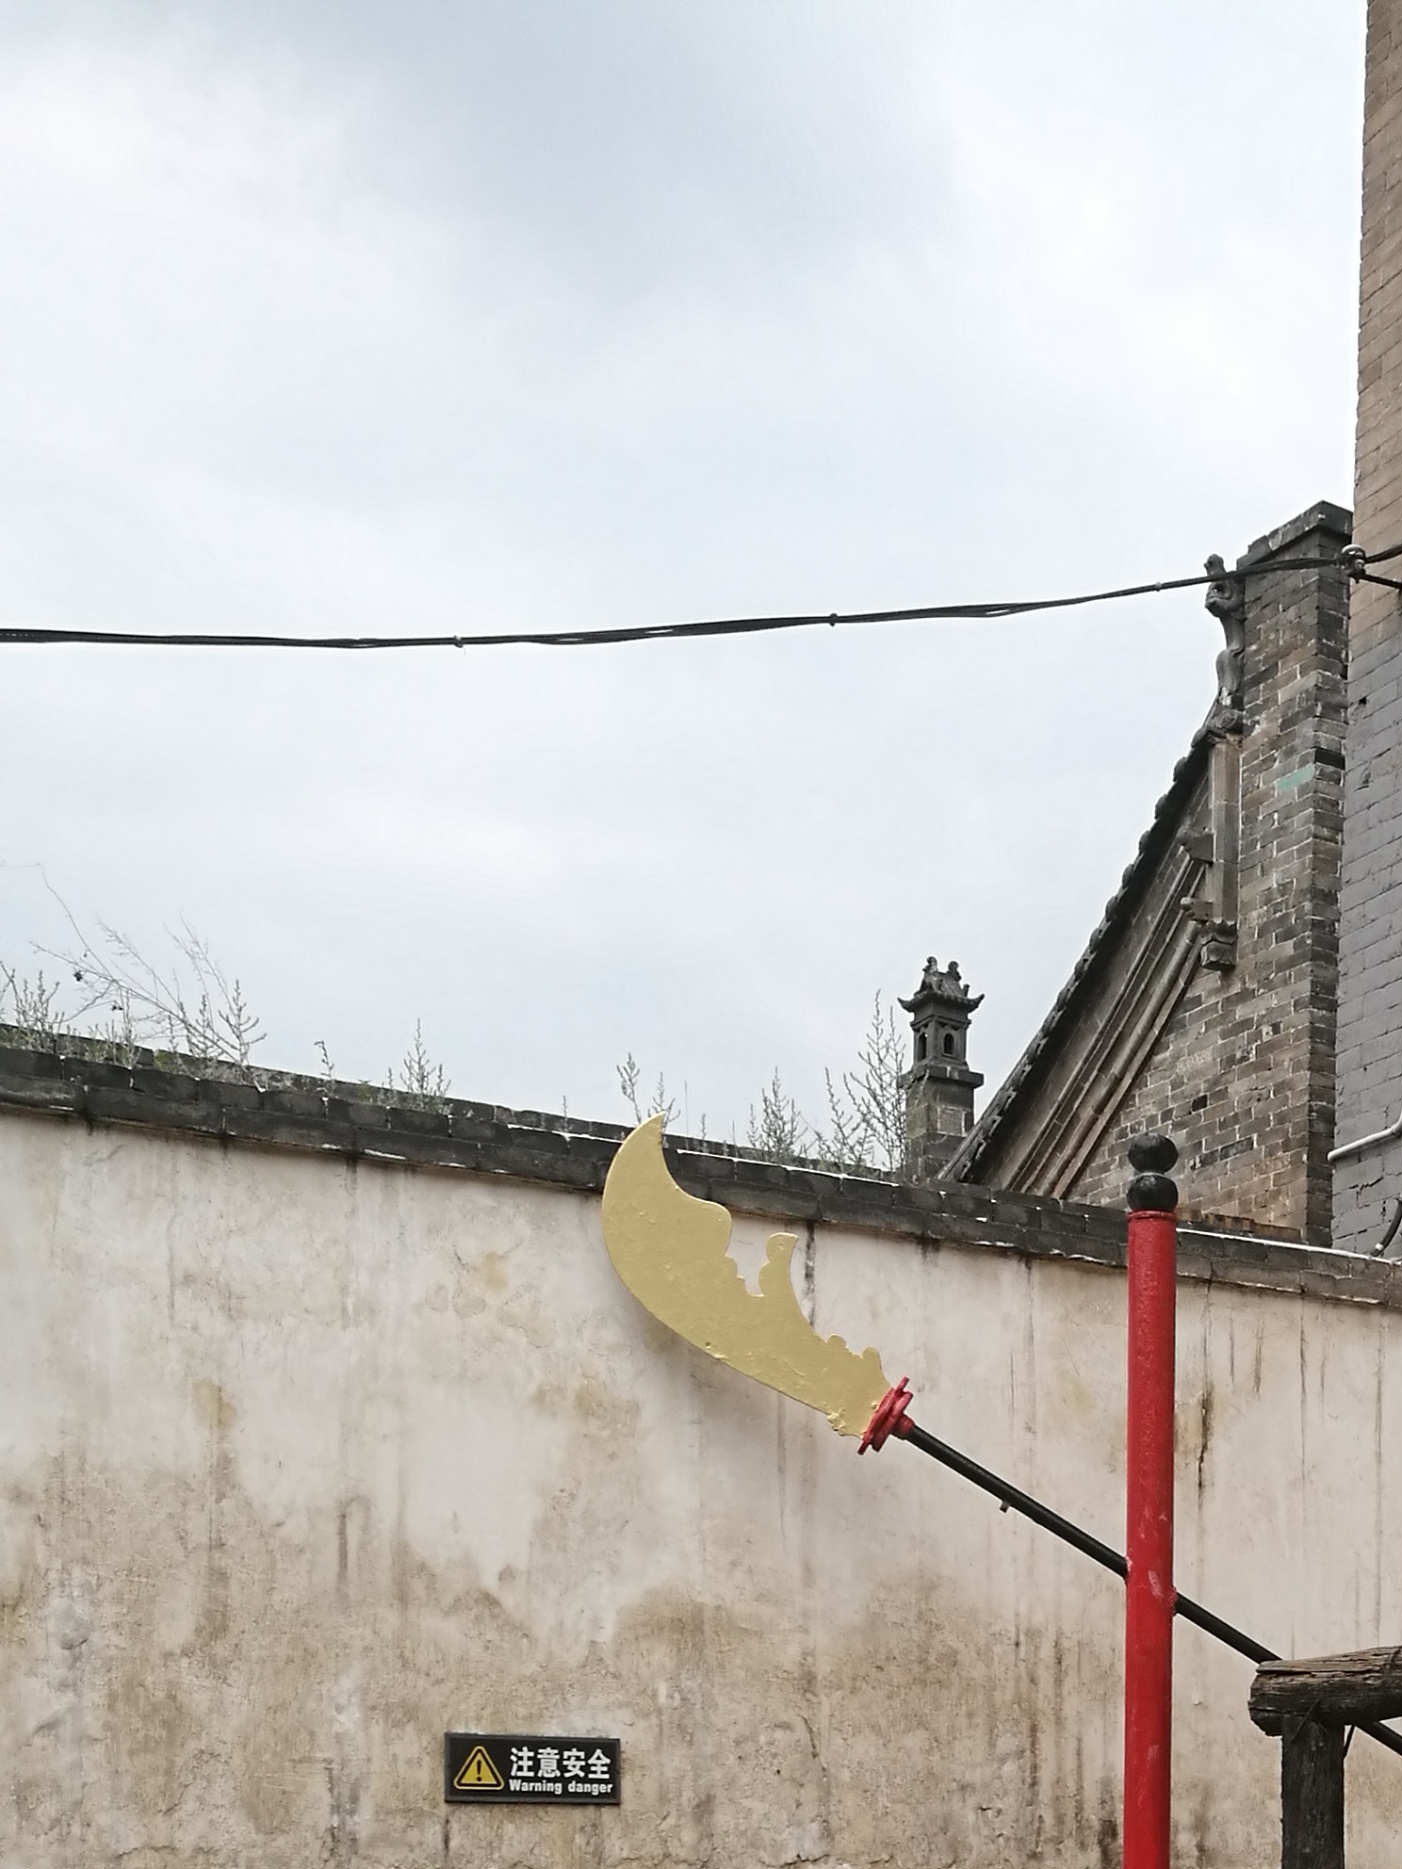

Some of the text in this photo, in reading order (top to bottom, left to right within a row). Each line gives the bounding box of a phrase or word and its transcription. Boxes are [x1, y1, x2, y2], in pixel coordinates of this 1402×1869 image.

[510, 1746, 611, 1779] 注意安全
[509, 1780, 613, 1795] Warning danger
